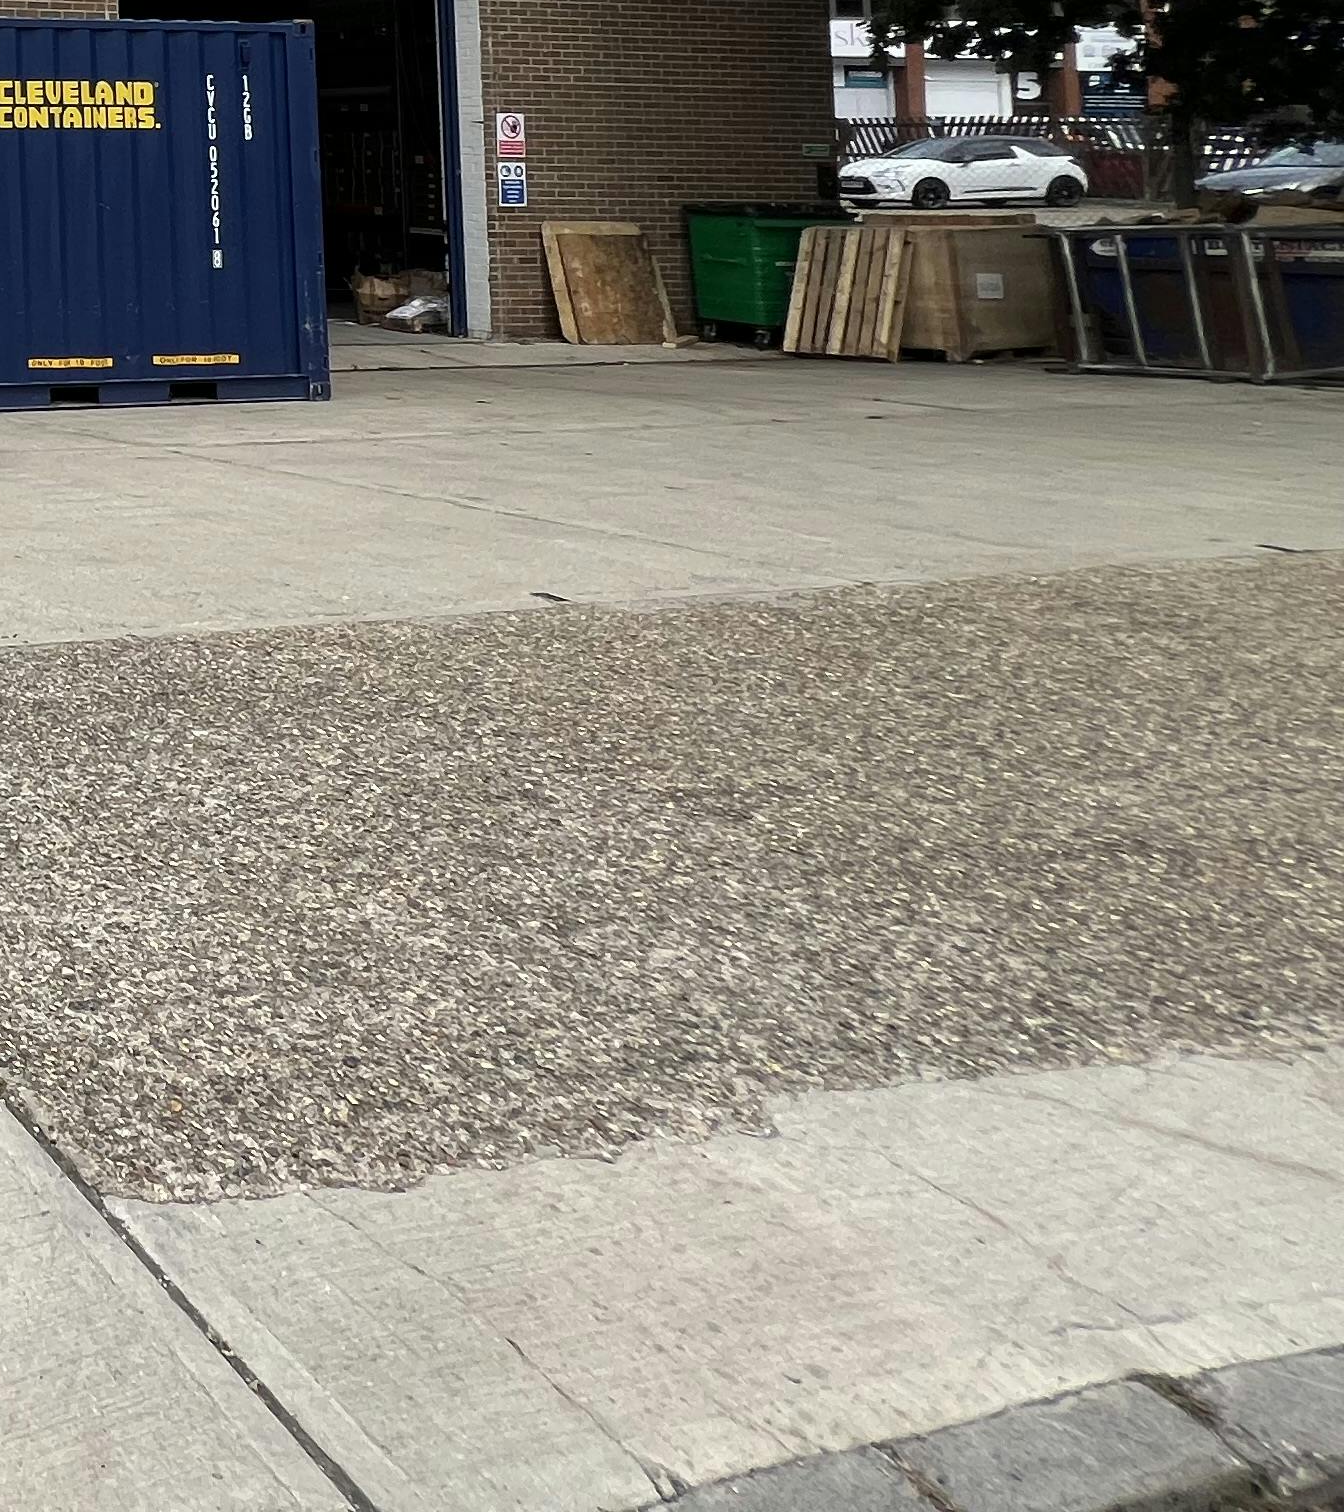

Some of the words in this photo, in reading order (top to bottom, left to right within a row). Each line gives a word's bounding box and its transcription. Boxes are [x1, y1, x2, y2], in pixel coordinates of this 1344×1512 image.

[206, 74, 217, 140] CVCU
[1016, 71, 1043, 100] 5
[208, 145, 221, 245] 052061
[213, 250, 223, 269] 8
